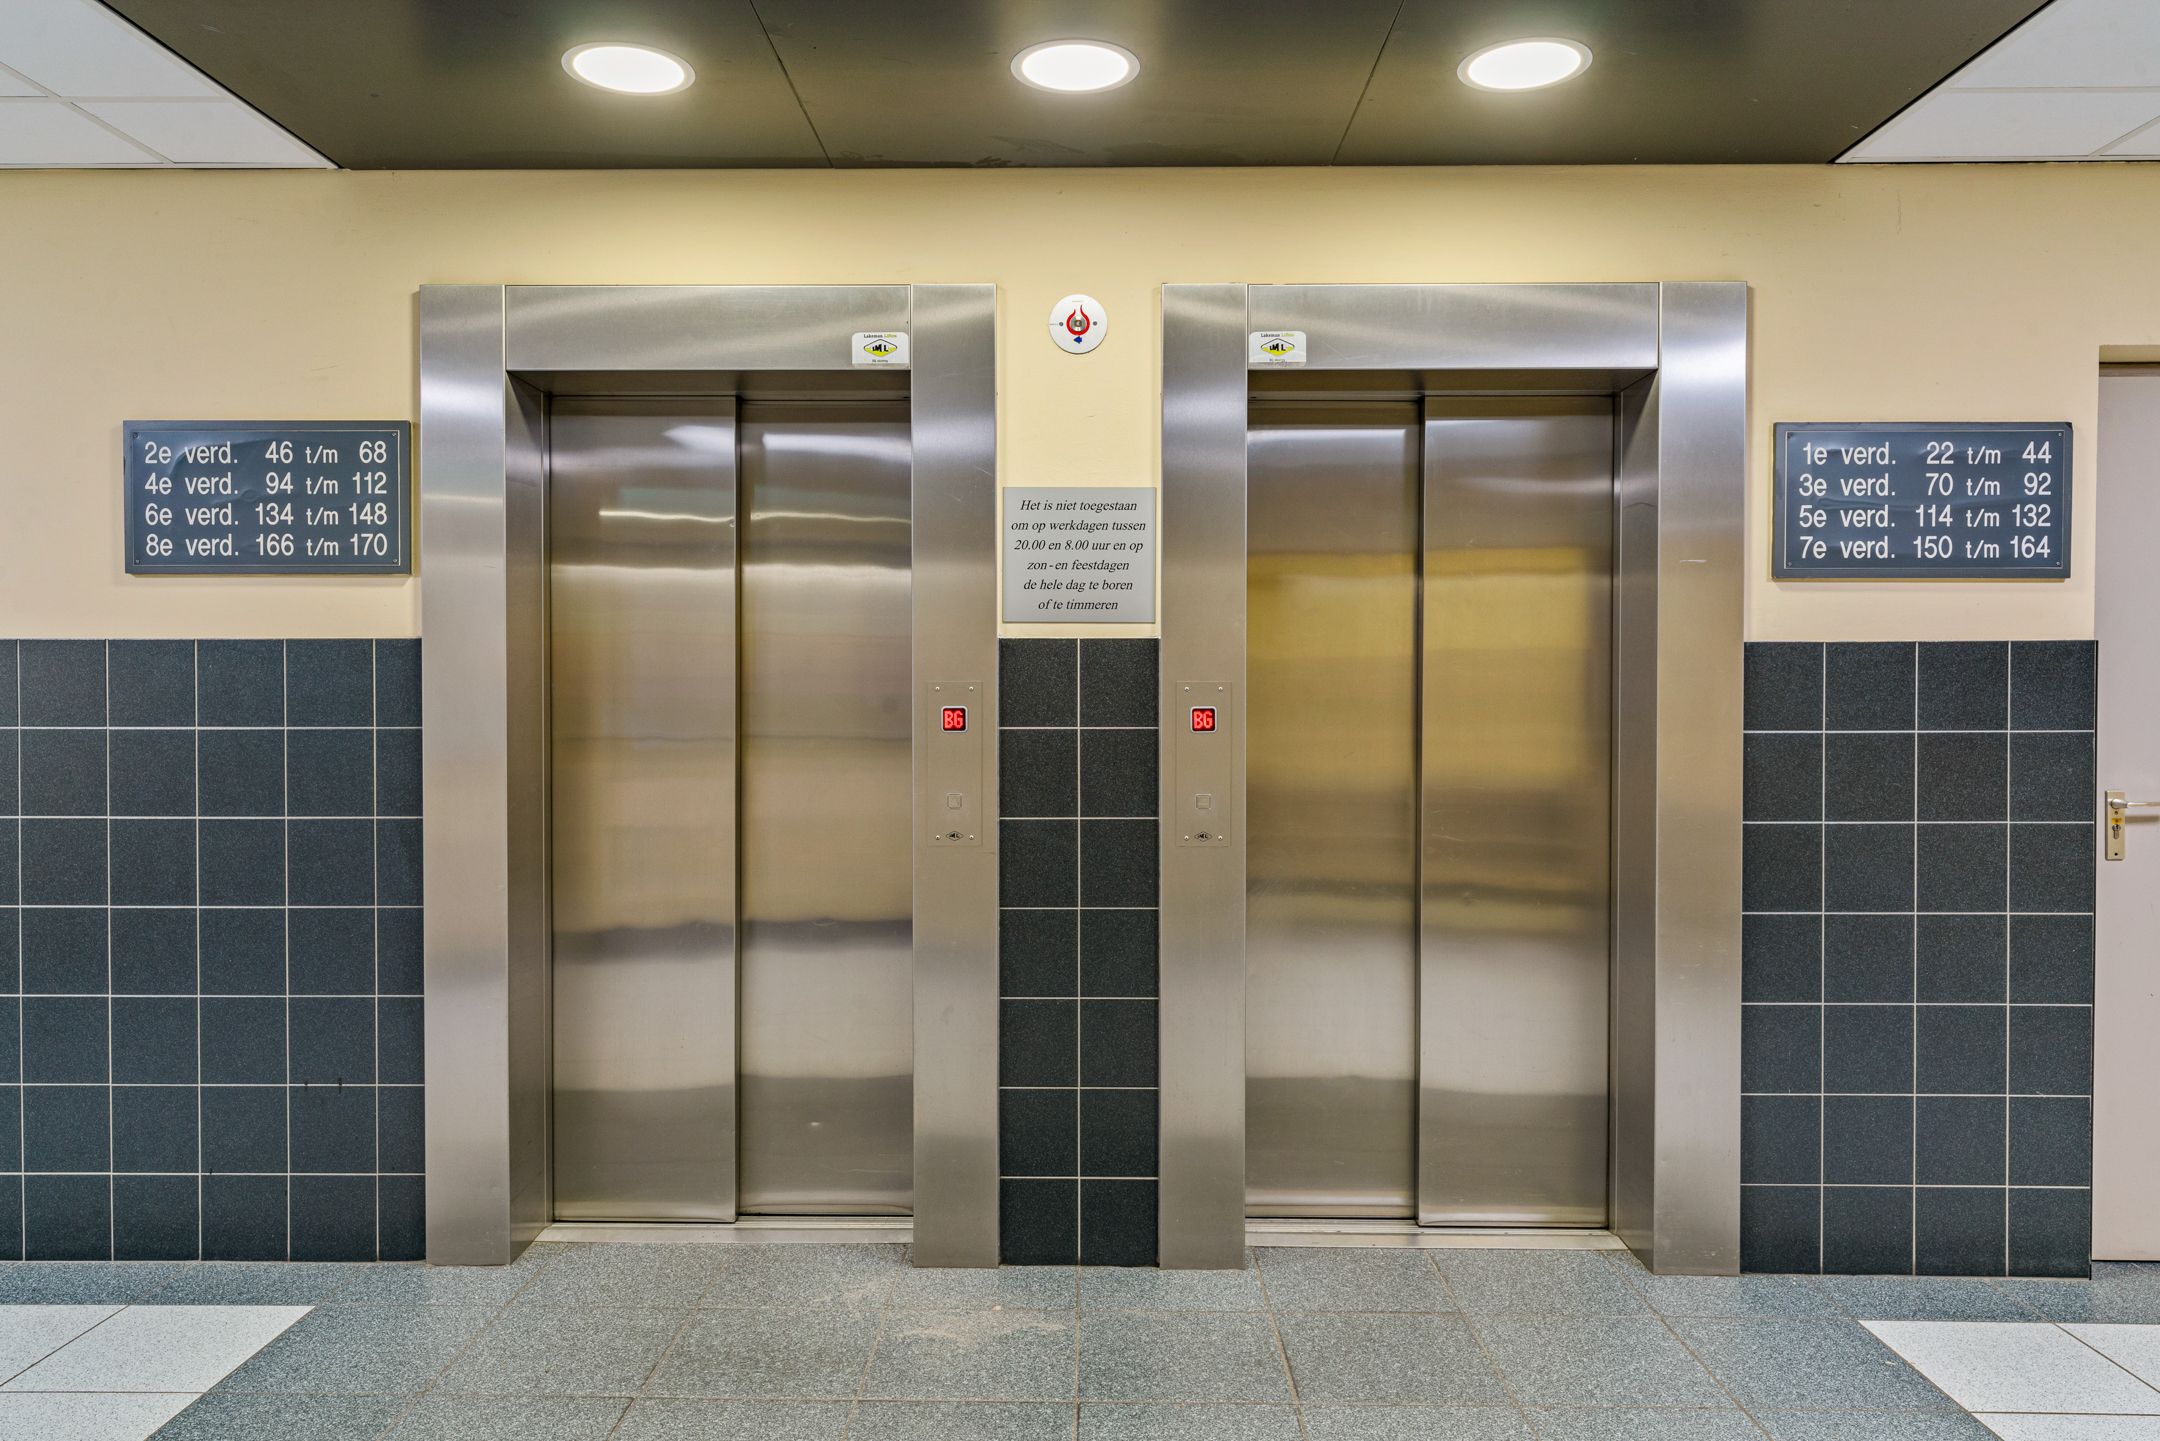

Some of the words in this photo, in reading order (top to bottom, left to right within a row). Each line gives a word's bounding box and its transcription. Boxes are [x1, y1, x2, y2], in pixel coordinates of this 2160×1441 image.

[144, 440, 173, 465] 2e
[184, 440, 239, 465] verd.
[264, 440, 294, 464] 46
[305, 445, 338, 464] t/m
[358, 440, 387, 464] 68
[1802, 441, 1828, 465] 1e
[1840, 441, 1896, 465] verd.
[1925, 440, 1955, 465] 22
[1966, 445, 2002, 465] t/m
[2021, 440, 2052, 464] 44
[144, 472, 173, 496] 4e
[184, 471, 239, 495] verd.
[265, 471, 294, 495] 94
[306, 475, 339, 495] t/m
[352, 471, 388, 495] 112
[1798, 473, 1828, 496] 3e
[1839, 472, 1896, 496] verd.
[1925, 472, 1954, 496] 70
[1965, 476, 2001, 496] t/m
[2023, 471, 2052, 496] 92
[144, 502, 173, 526] 6e
[184, 502, 239, 526] verd.
[255, 502, 295, 526] 134
[306, 506, 339, 526] t/m
[348, 501, 388, 526] 148
[1020, 499, 1041, 511] Het
[1043, 499, 1053, 511] is
[1055, 499, 1077, 511] niet
[1079, 501, 1138, 514] toegestaan
[1799, 504, 1827, 528] 5e
[1839, 504, 1896, 528] verd.
[1915, 503, 1954, 528] 114
[1965, 508, 2000, 528] t/m
[2011, 503, 2052, 528] 132
[1010, 522, 1029, 531] om
[1031, 522, 1047, 534] op
[1049, 519, 1109, 534] werkdagen
[1111, 521, 1147, 531] tussen
[145, 533, 173, 557] 8e
[185, 532, 239, 557] verd.
[255, 533, 295, 557] 166
[307, 537, 339, 557] t/m
[349, 532, 388, 556] 170
[1013, 539, 1046, 551] 20.00
[1048, 542, 1062, 551] en
[1064, 539, 1090, 551] 8.00
[1091, 542, 1112, 551] uur
[1112, 542, 1127, 551] en
[1129, 542, 1144, 554] op
[1799, 535, 1827, 559] 7e
[1839, 535, 1896, 559] verd.
[1912, 534, 1953, 559] 150
[1965, 539, 2000, 559] t/m
[2009, 534, 2051, 559] 164
[1054, 562, 1068, 570] en
[1071, 559, 1130, 573] feestdagen
[1023, 578, 1038, 590] de
[1039, 578, 1063, 590] hele
[1065, 578, 1087, 593] dag
[1088, 581, 1100, 590] te
[1101, 578, 1134, 591] boren
[1038, 598, 1053, 610] of
[1052, 600, 1064, 610] te
[1066, 598, 1119, 610] timmeren
[944, 710, 964, 729] BG
[1193, 710, 1213, 729] BG
